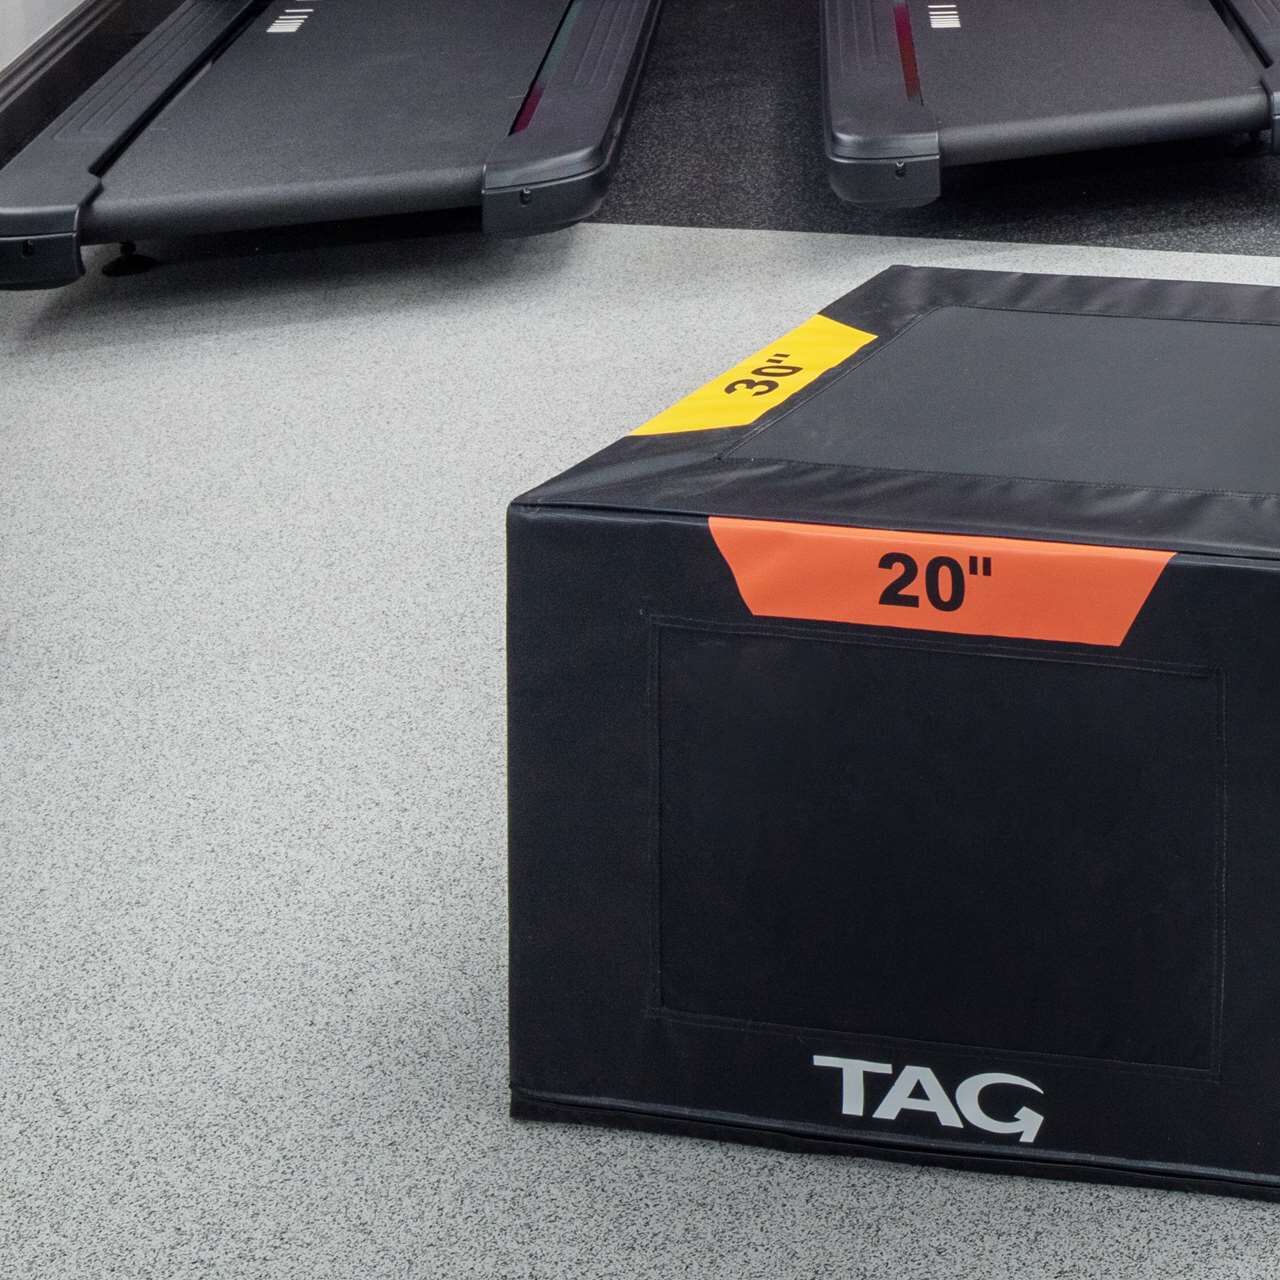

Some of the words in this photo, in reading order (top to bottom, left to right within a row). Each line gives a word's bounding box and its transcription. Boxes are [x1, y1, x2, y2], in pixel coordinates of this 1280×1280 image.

[724, 353, 804, 397] 30"
[878, 551, 992, 612] 20"
[812, 1054, 1044, 1144] TAG
